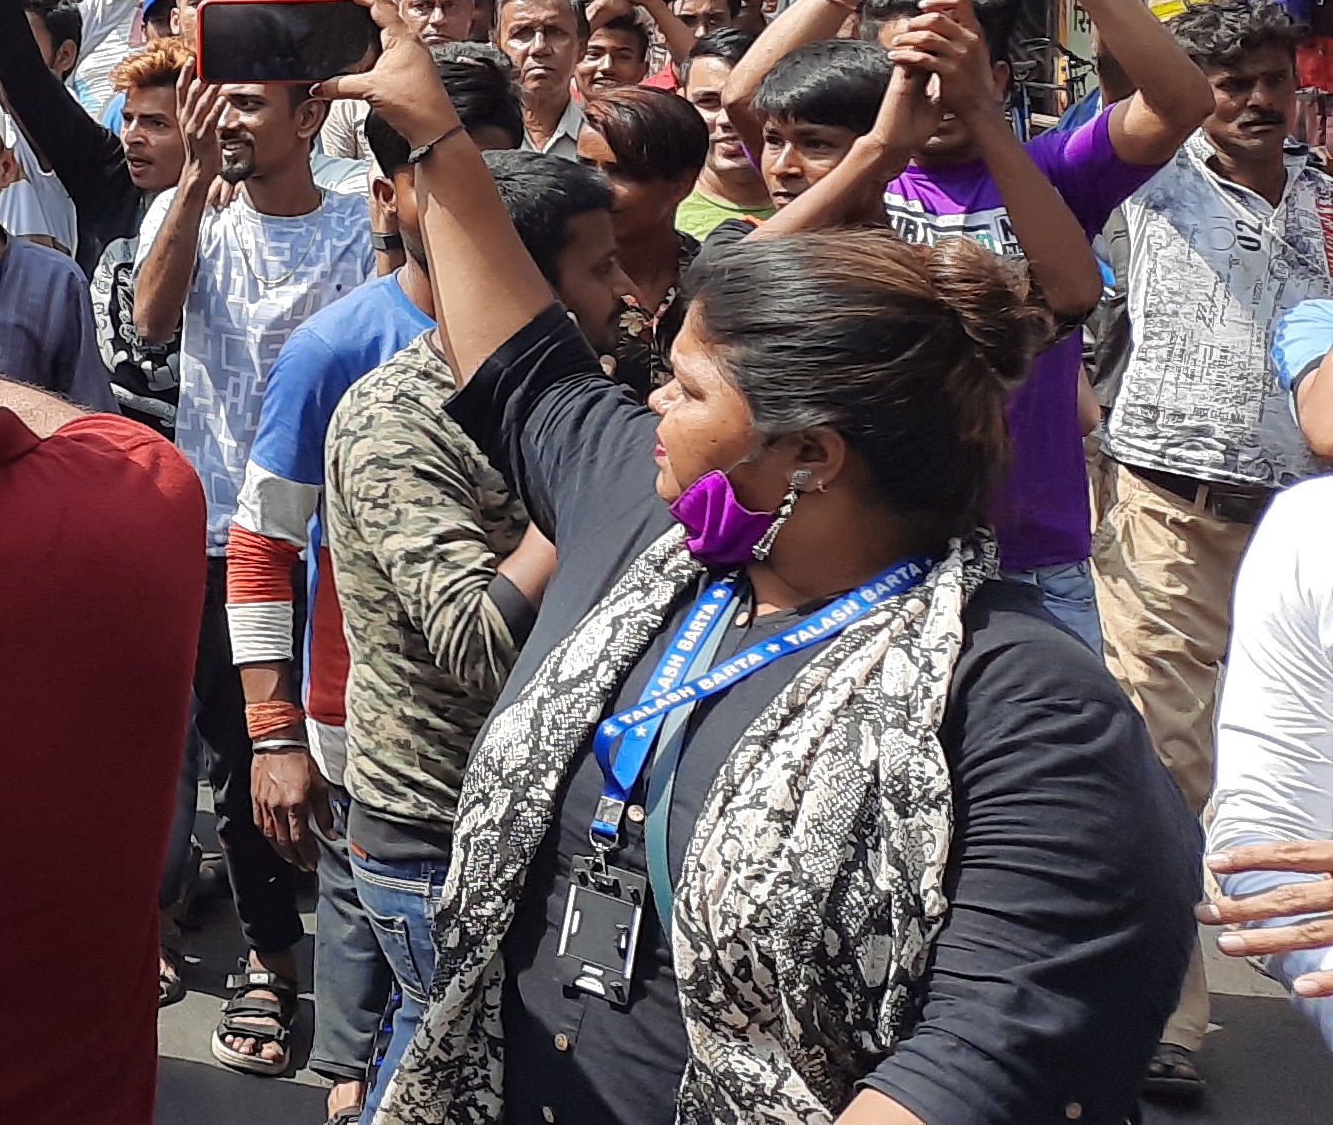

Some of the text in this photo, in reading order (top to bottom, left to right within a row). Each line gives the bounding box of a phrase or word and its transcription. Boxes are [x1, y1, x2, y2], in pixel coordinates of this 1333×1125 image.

[676, 603, 719, 651] BARTA
[783, 560, 923, 647] TALASH BARTA
[618, 652, 764, 726] TALASH BARTA
